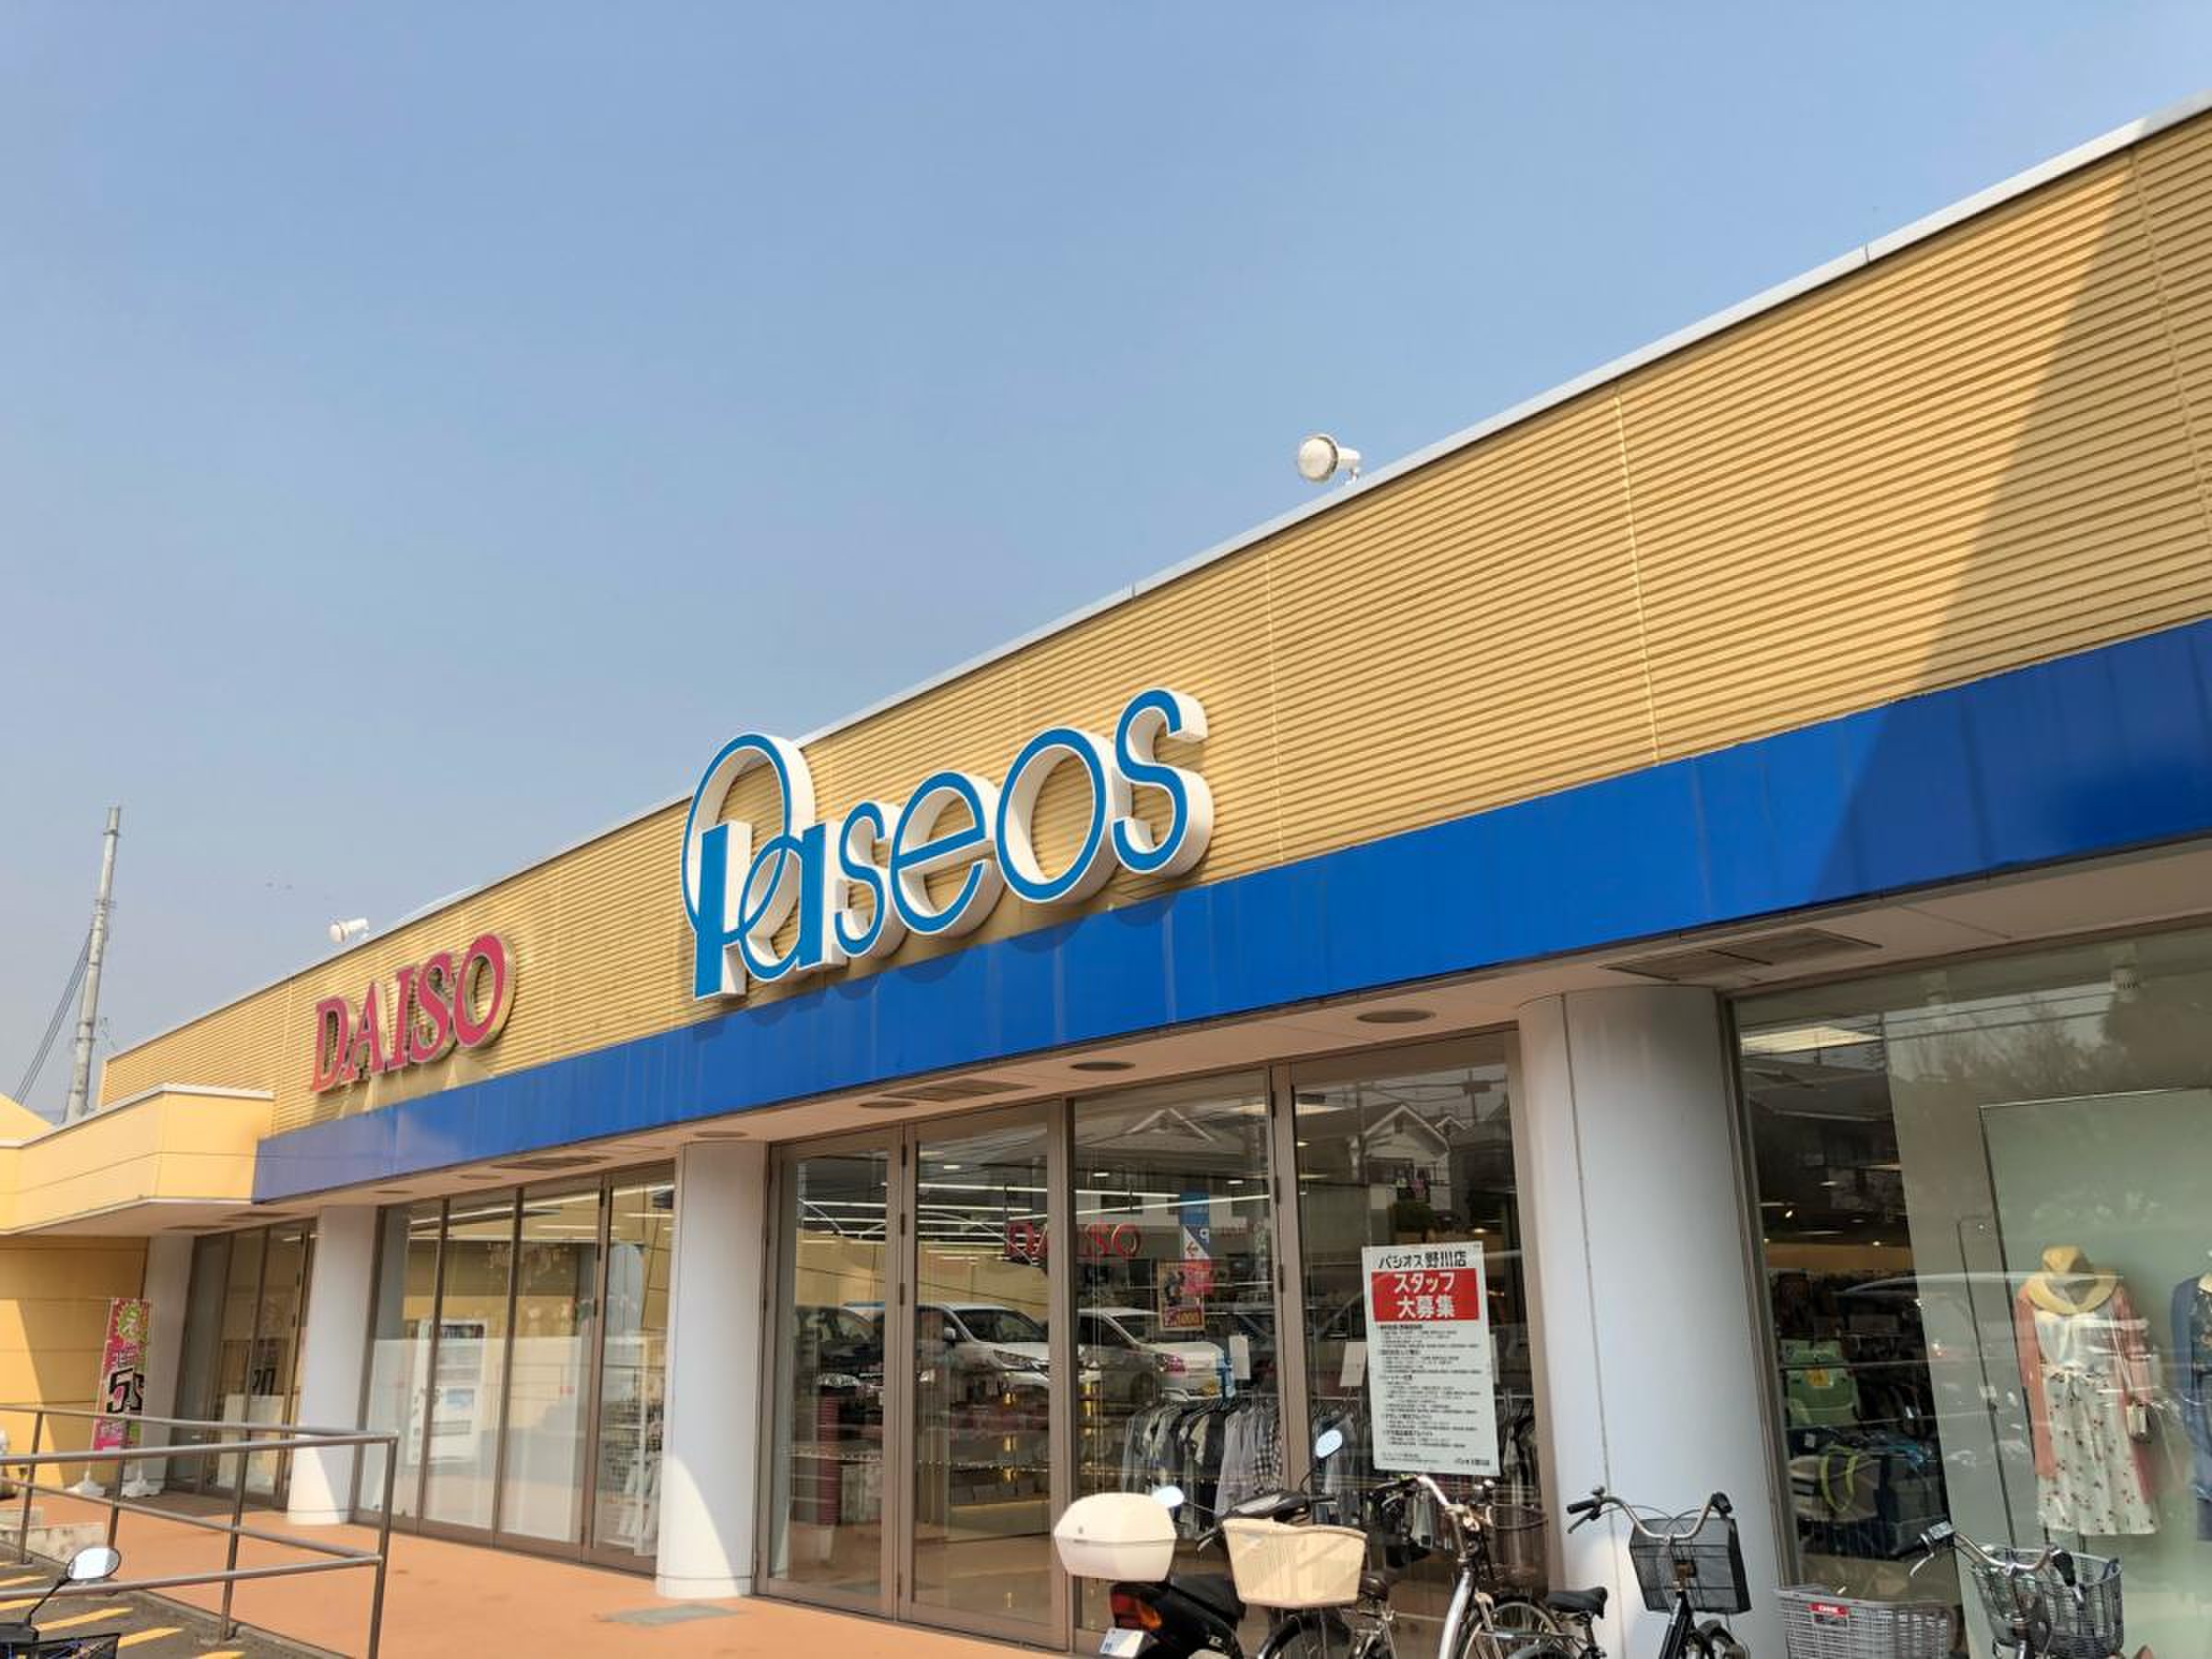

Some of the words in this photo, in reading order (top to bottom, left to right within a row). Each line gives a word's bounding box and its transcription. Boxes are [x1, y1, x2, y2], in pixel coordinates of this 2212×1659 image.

[682, 688, 1211, 999] Paseos
[312, 934, 513, 1092] DAISO
[1394, 1272, 1455, 1294] スタッフ
[1396, 1294, 1455, 1319] 大募集
